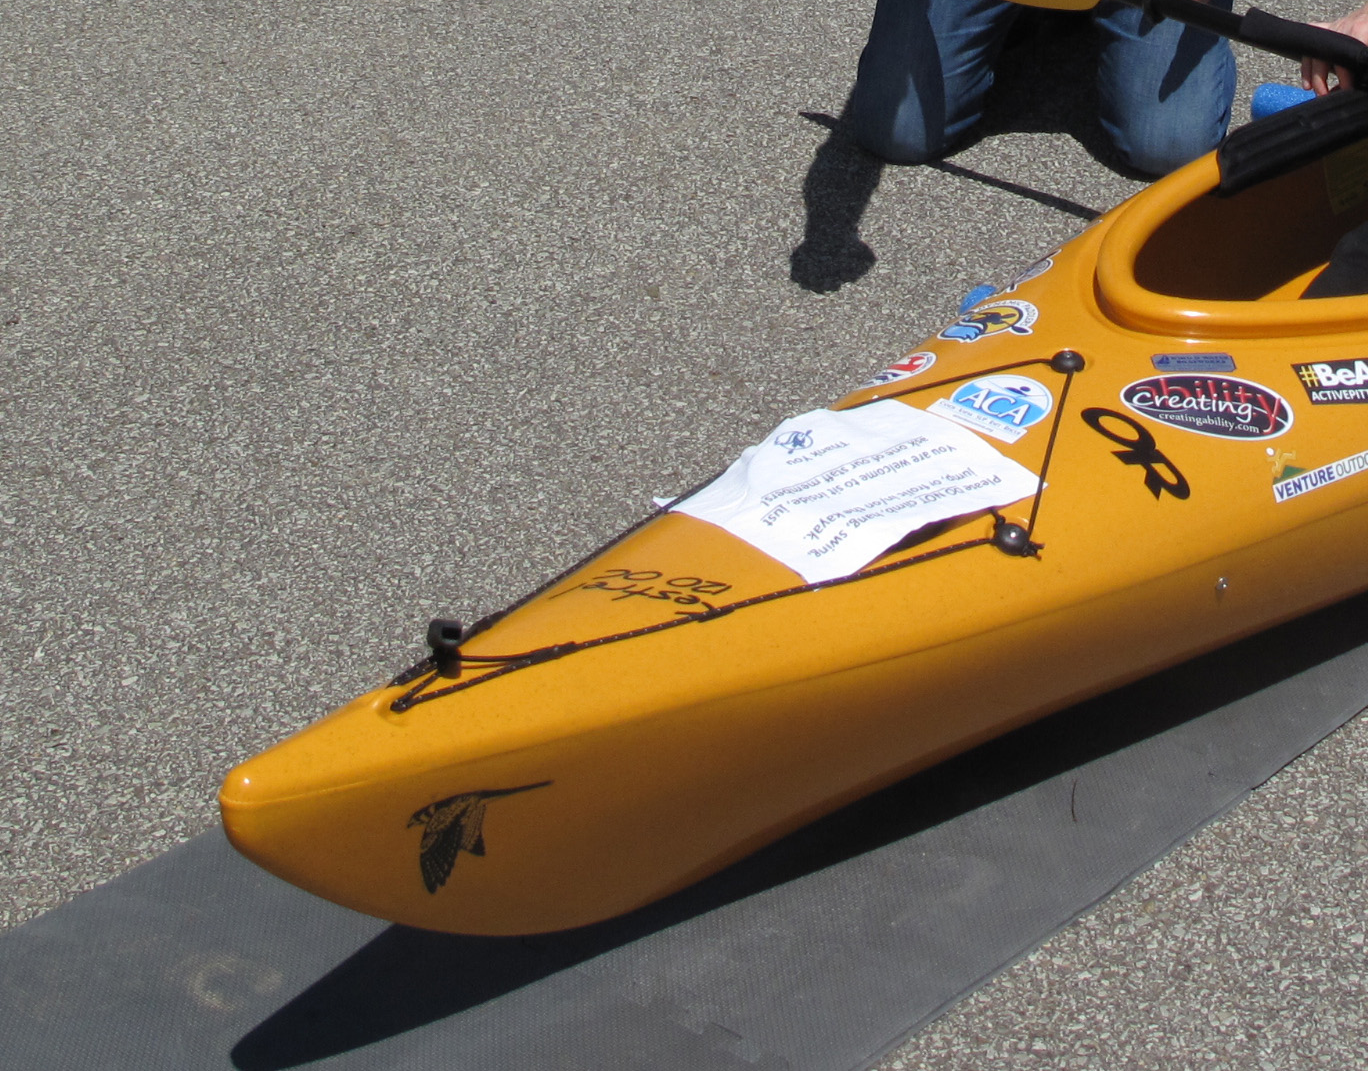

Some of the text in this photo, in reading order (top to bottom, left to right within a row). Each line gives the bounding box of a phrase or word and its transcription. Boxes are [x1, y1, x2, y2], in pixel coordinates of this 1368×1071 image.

[958, 388, 1030, 425] ACA
[1132, 392, 1254, 423] creating
[1159, 413, 1260, 434] creatingability.com
[786, 441, 850, 466] Thank You
[1080, 407, 1191, 500] OR
[760, 436, 928, 506] ask one of our staff members!
[941, 467, 978, 481] jump,
[761, 445, 957, 526] You are welcome to sit inside, just
[897, 484, 930, 497] frolic
[944, 486, 964, 496] DO
[964, 475, 1002, 490] Please
[1275, 466, 1335, 499] VENTURE
[864, 494, 900, 509] in/on
[881, 500, 917, 513] climb,
[921, 490, 946, 504] NOT
[803, 512, 847, 540] kayak.
[846, 512, 885, 528] hang,
